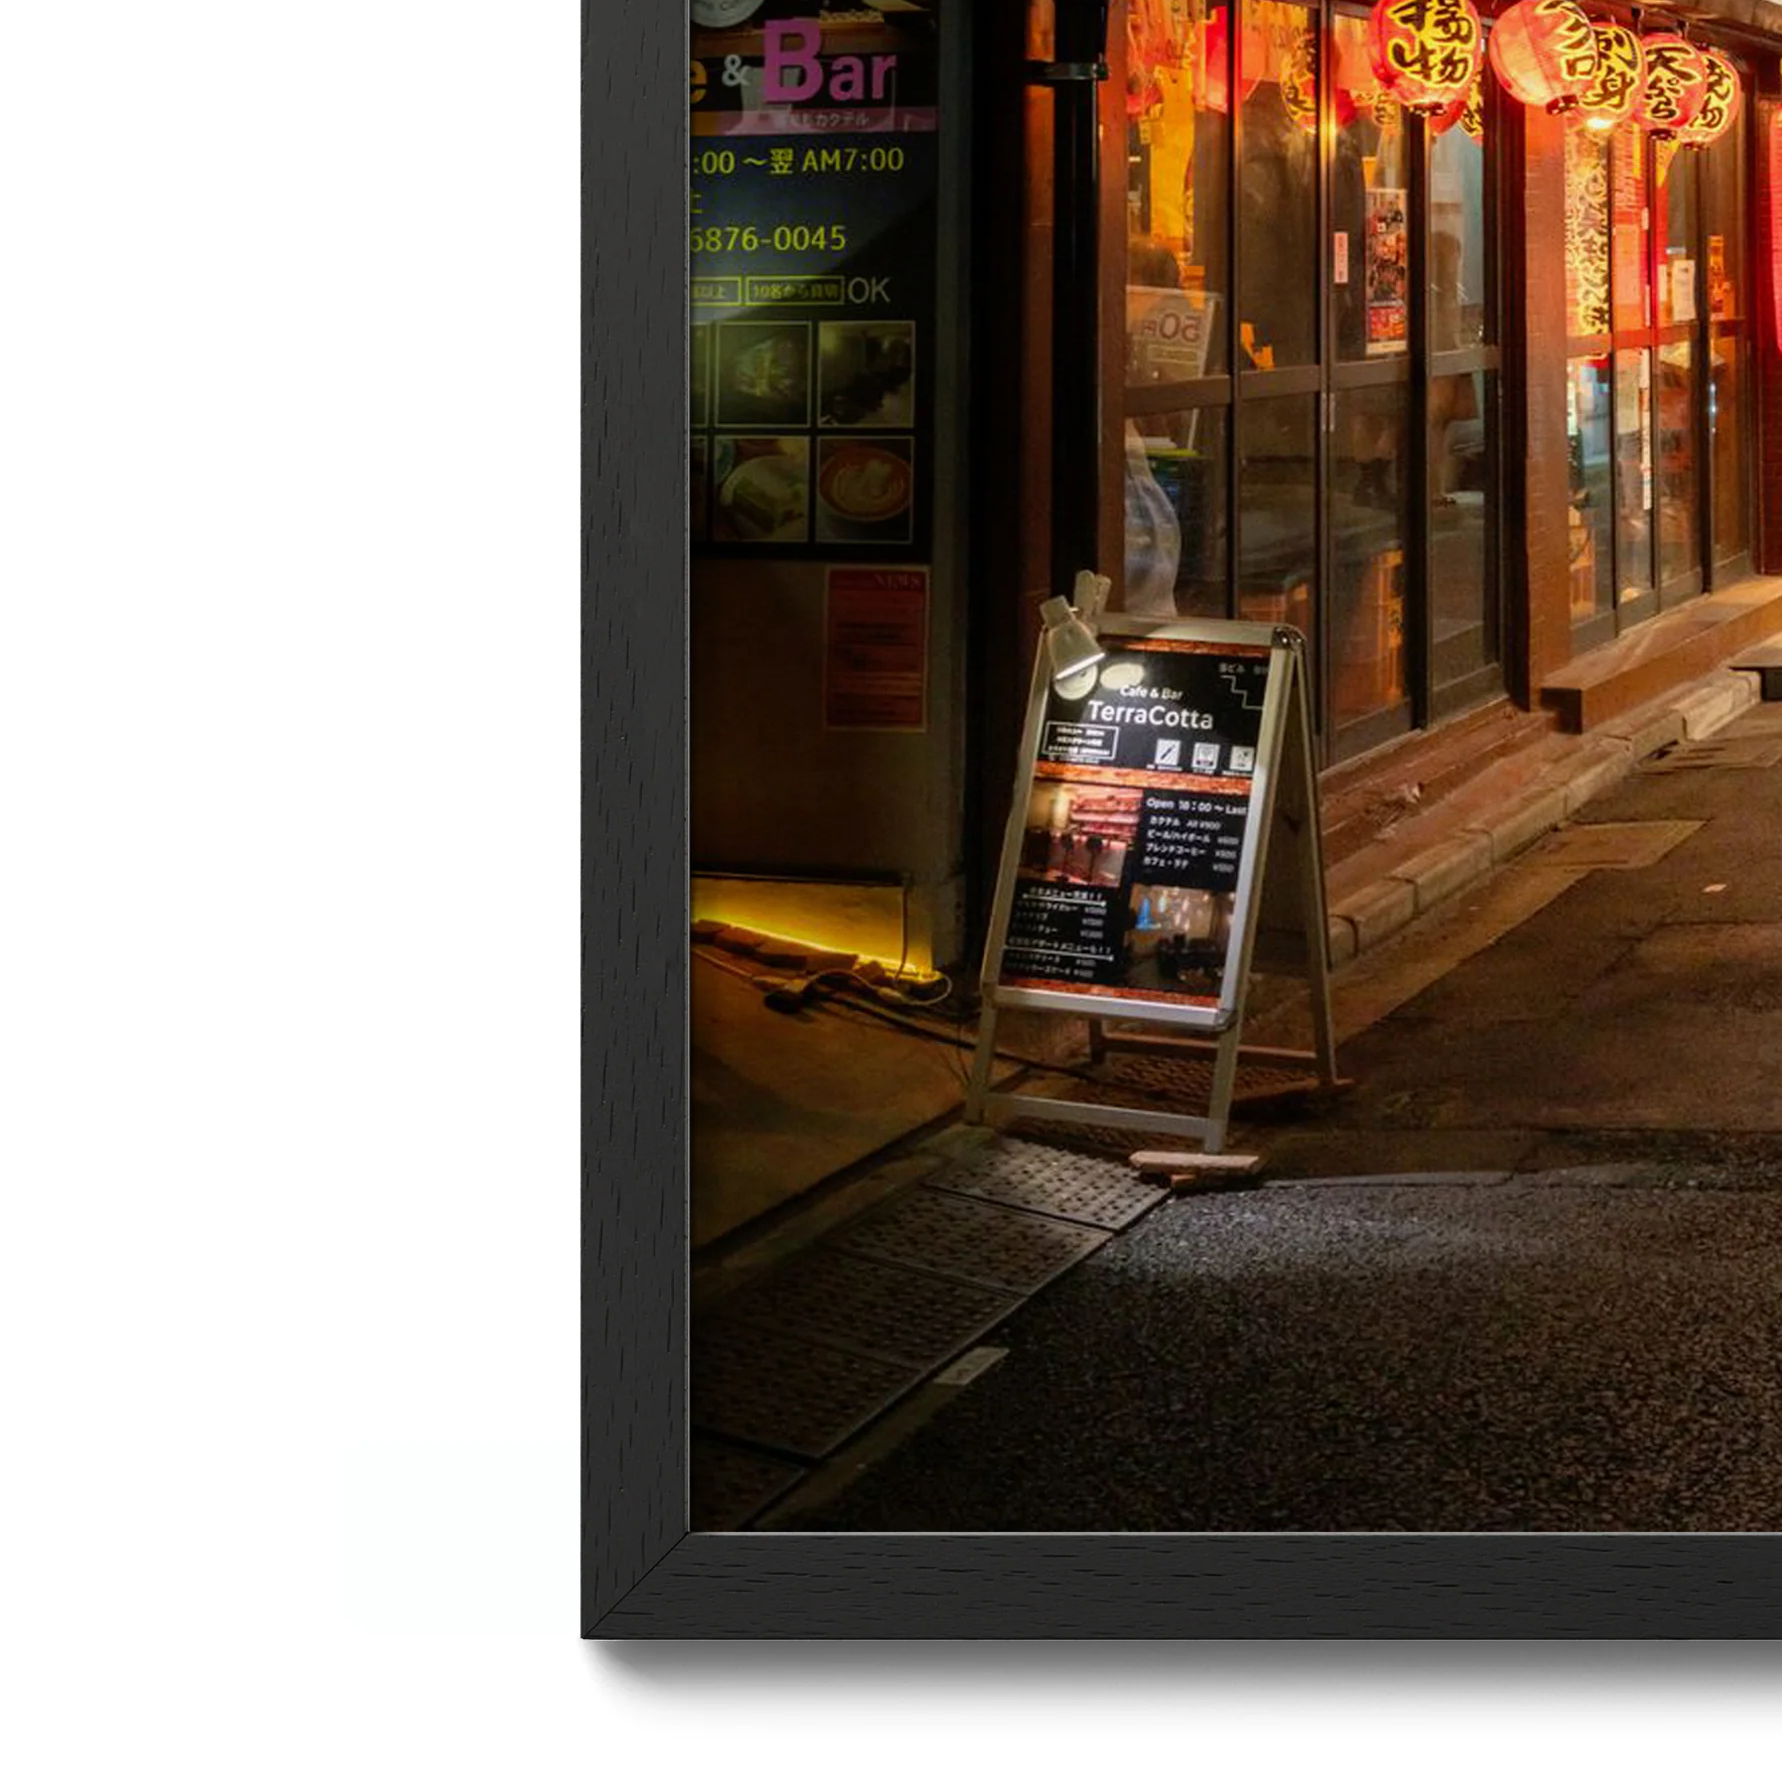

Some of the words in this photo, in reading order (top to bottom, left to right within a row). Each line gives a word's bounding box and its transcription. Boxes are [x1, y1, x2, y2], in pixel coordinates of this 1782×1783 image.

[722, 55, 750, 87] &
[764, 18, 897, 104] Bar
[1644, 45, 1701, 119] 天ぷら
[802, 147, 905, 173] AM7:00
[690, 225, 846, 252] 6876-0045
[848, 276, 892, 304] OK
[1119, 684, 1148, 700] Cafe
[1149, 686, 1160, 699] &
[1161, 686, 1184, 701] Bar
[1086, 699, 1215, 731] TerraCotta
[1145, 796, 1175, 811] Open
